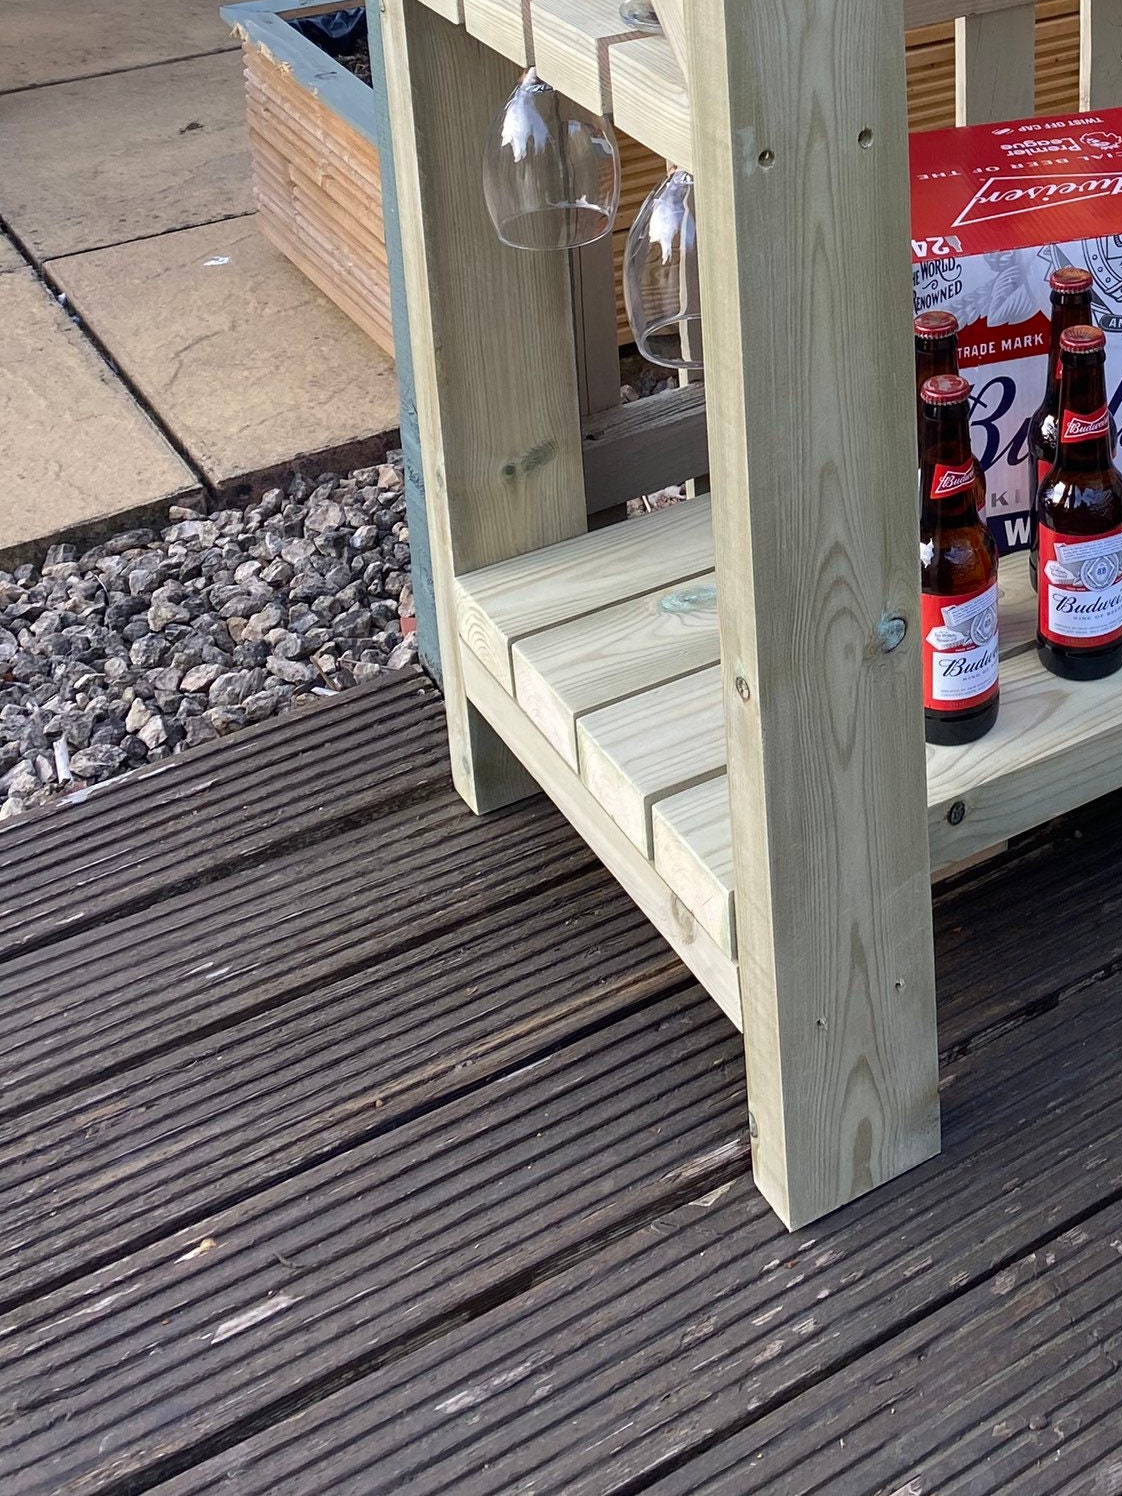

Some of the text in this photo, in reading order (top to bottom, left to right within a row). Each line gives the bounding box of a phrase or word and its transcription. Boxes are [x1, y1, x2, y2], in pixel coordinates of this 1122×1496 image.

[1018, 117, 1104, 133] TWIST OFF CAP
[1000, 136, 1076, 151] League
[1006, 141, 1082, 157] Premier
[972, 165, 1001, 174] OF
[1009, 158, 1070, 170] BEER
[916, 169, 962, 181] THE
[957, 332, 1044, 360] TRADE MARK
